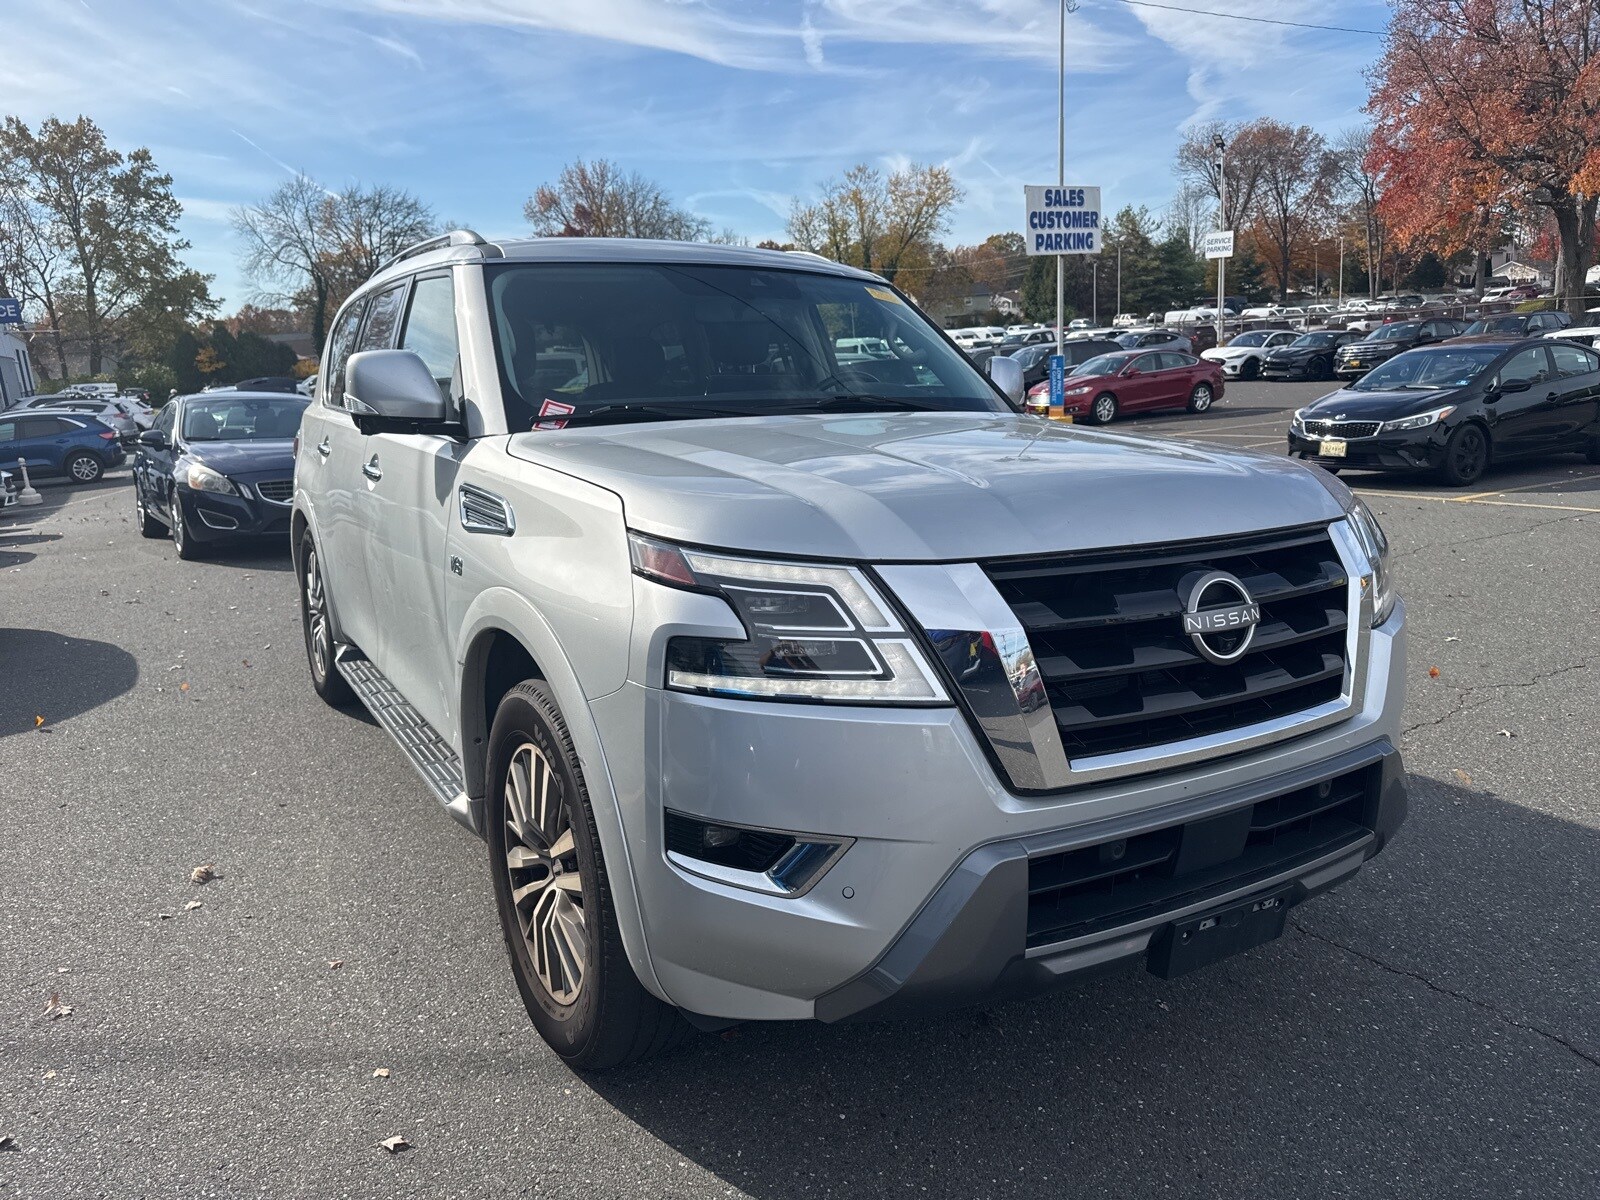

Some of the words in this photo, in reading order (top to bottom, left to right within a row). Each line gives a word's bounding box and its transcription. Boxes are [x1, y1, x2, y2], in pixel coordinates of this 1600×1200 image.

[1045, 189, 1085, 207] SALES
[1029, 211, 1099, 229] CUSTOMER
[1036, 232, 1094, 251] PARKING
[1206, 237, 1232, 245] SERVICE
[1206, 245, 1232, 253] PARKING
[1186, 607, 1260, 630] NISSAN
